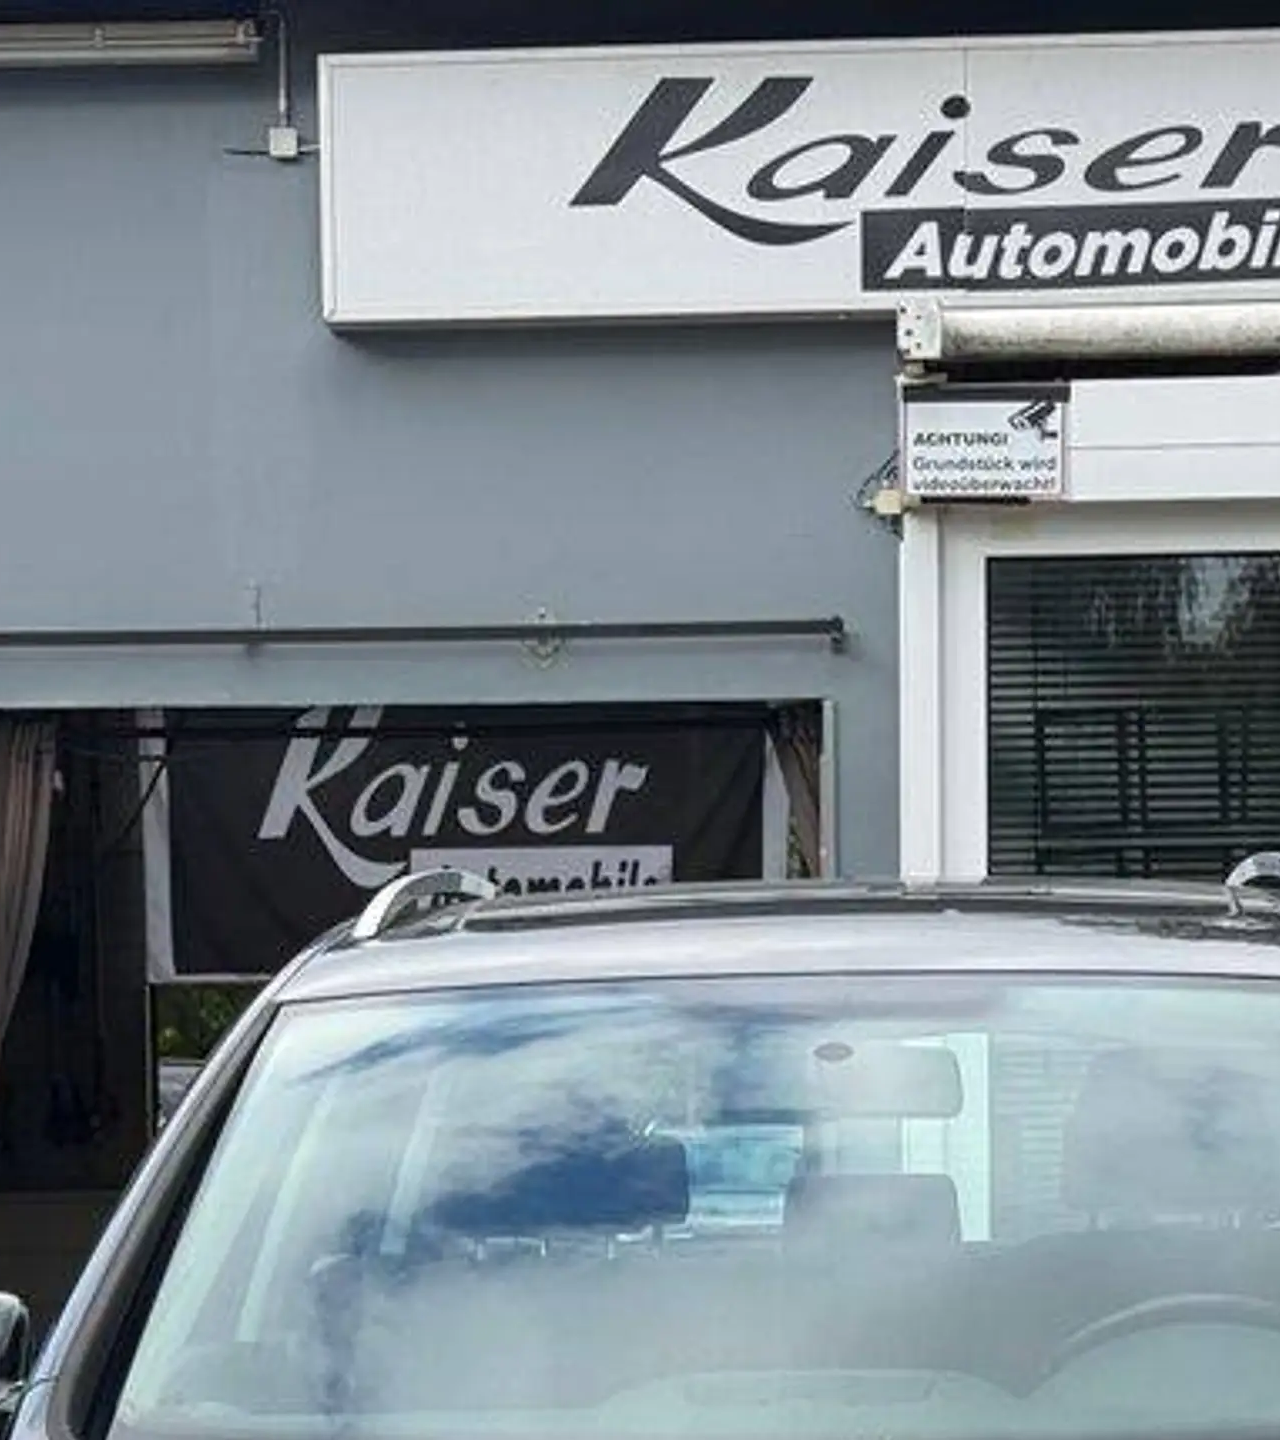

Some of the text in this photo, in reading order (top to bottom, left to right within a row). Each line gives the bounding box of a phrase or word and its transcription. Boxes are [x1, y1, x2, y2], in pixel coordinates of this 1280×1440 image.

[913, 432, 1009, 447] ACHTUNG!
[913, 455, 1057, 471] Grundstück wird
[257, 704, 650, 890] Kaiser
